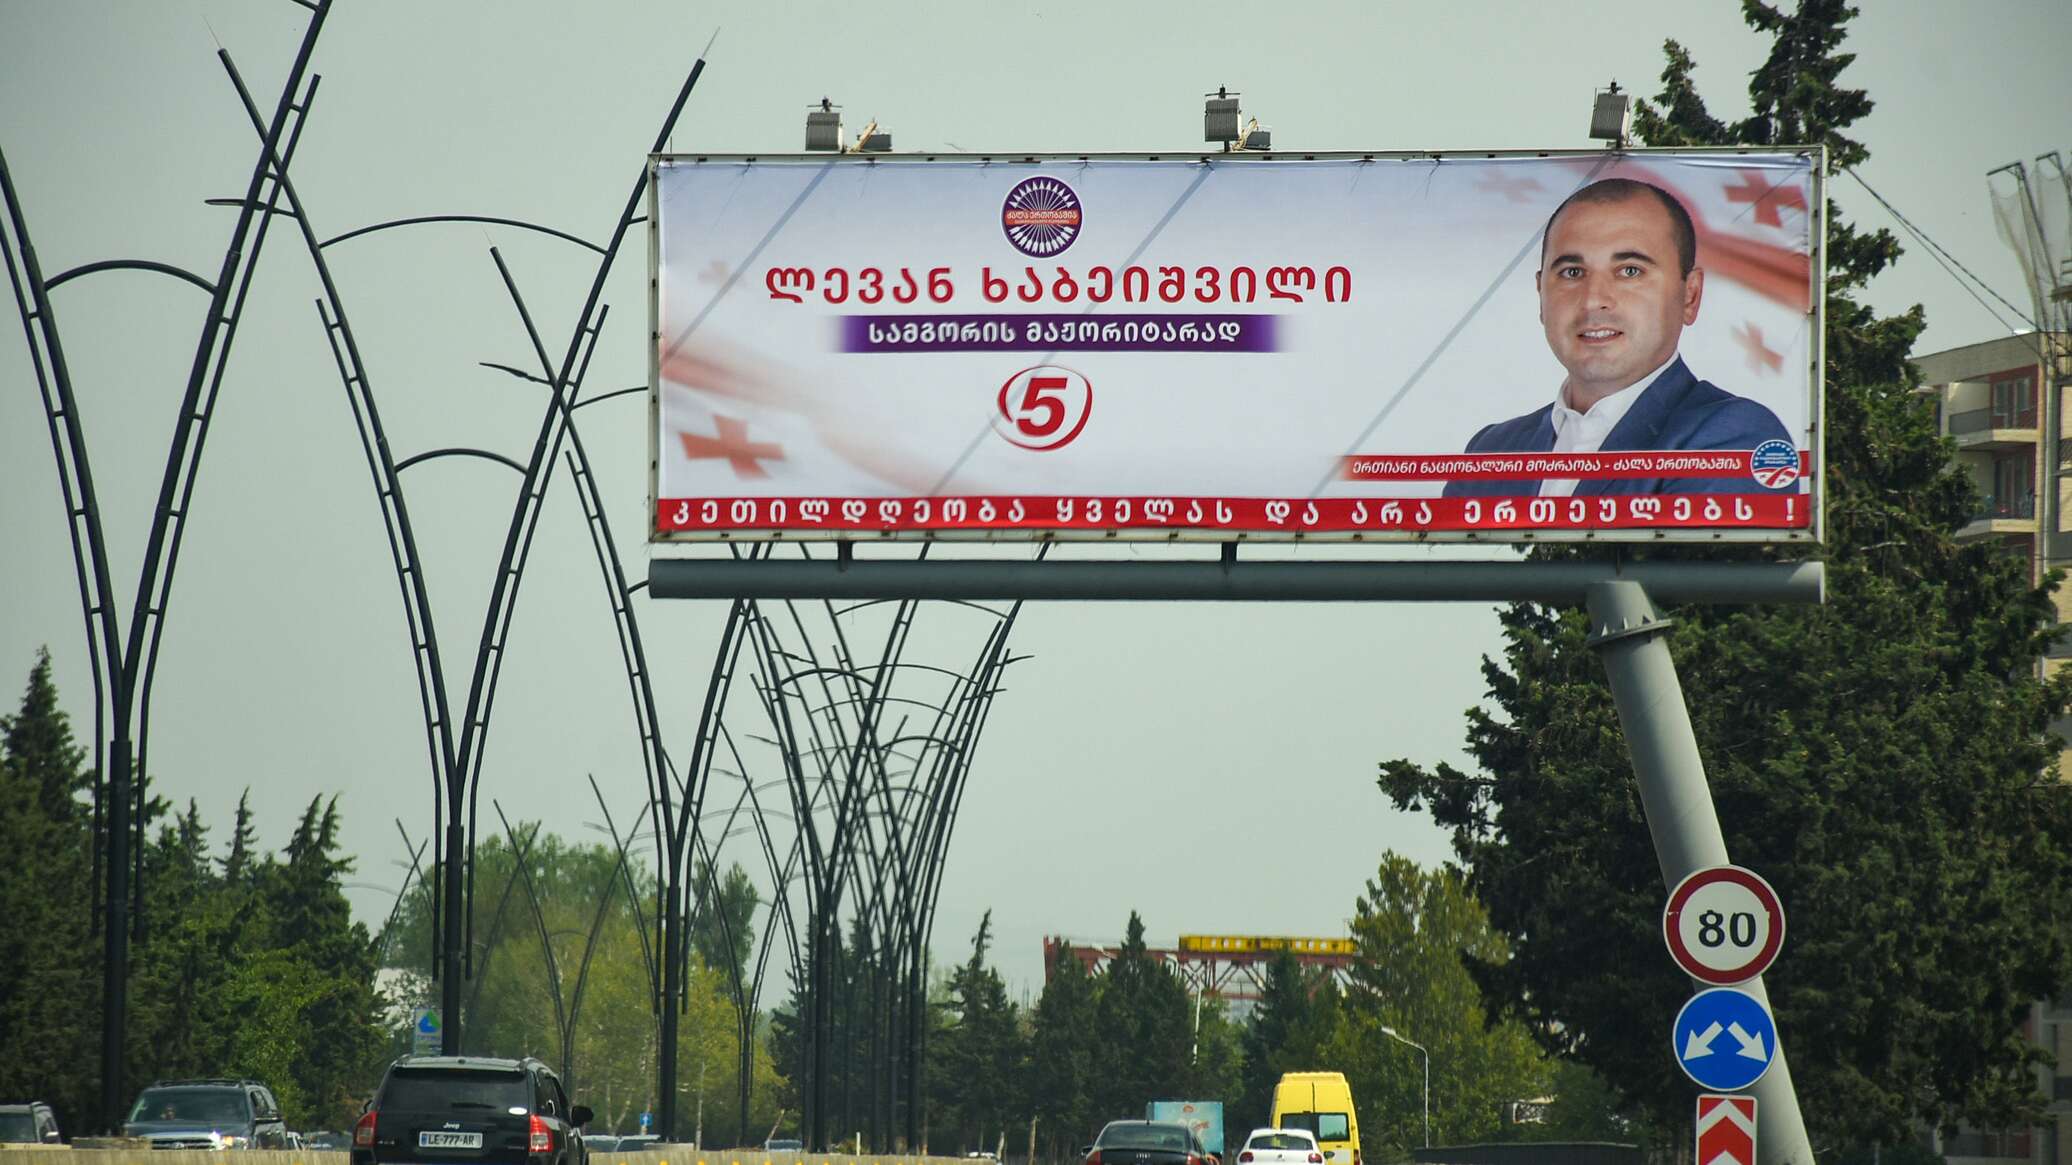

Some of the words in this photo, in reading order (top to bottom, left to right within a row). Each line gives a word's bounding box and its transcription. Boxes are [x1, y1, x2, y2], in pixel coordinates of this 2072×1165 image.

[766, 267, 954, 304] ლევან
[981, 266, 1352, 303] ხაბეიშვილი
[868, 322, 1016, 344] სამგორის
[1026, 321, 1241, 343] მაჟორიტარად
[1015, 377, 1068, 437] 5
[1352, 461, 1417, 474] ერთიანი
[1420, 459, 1523, 474] ნაციონალური
[1526, 458, 1601, 473] მოძრაობა
[1613, 458, 1652, 471] ძალა
[1656, 457, 1741, 471] ერთობაშია
[672, 500, 1026, 525] კეთილდღეობა
[1056, 500, 1233, 525] ყველას
[1265, 500, 1320, 526] და
[1351, 501, 1433, 526] არა
[1464, 499, 1753, 525] ერთეულებს
[1698, 909, 1757, 948] 80
[428, 1133, 475, 1146] LE-777-AR
